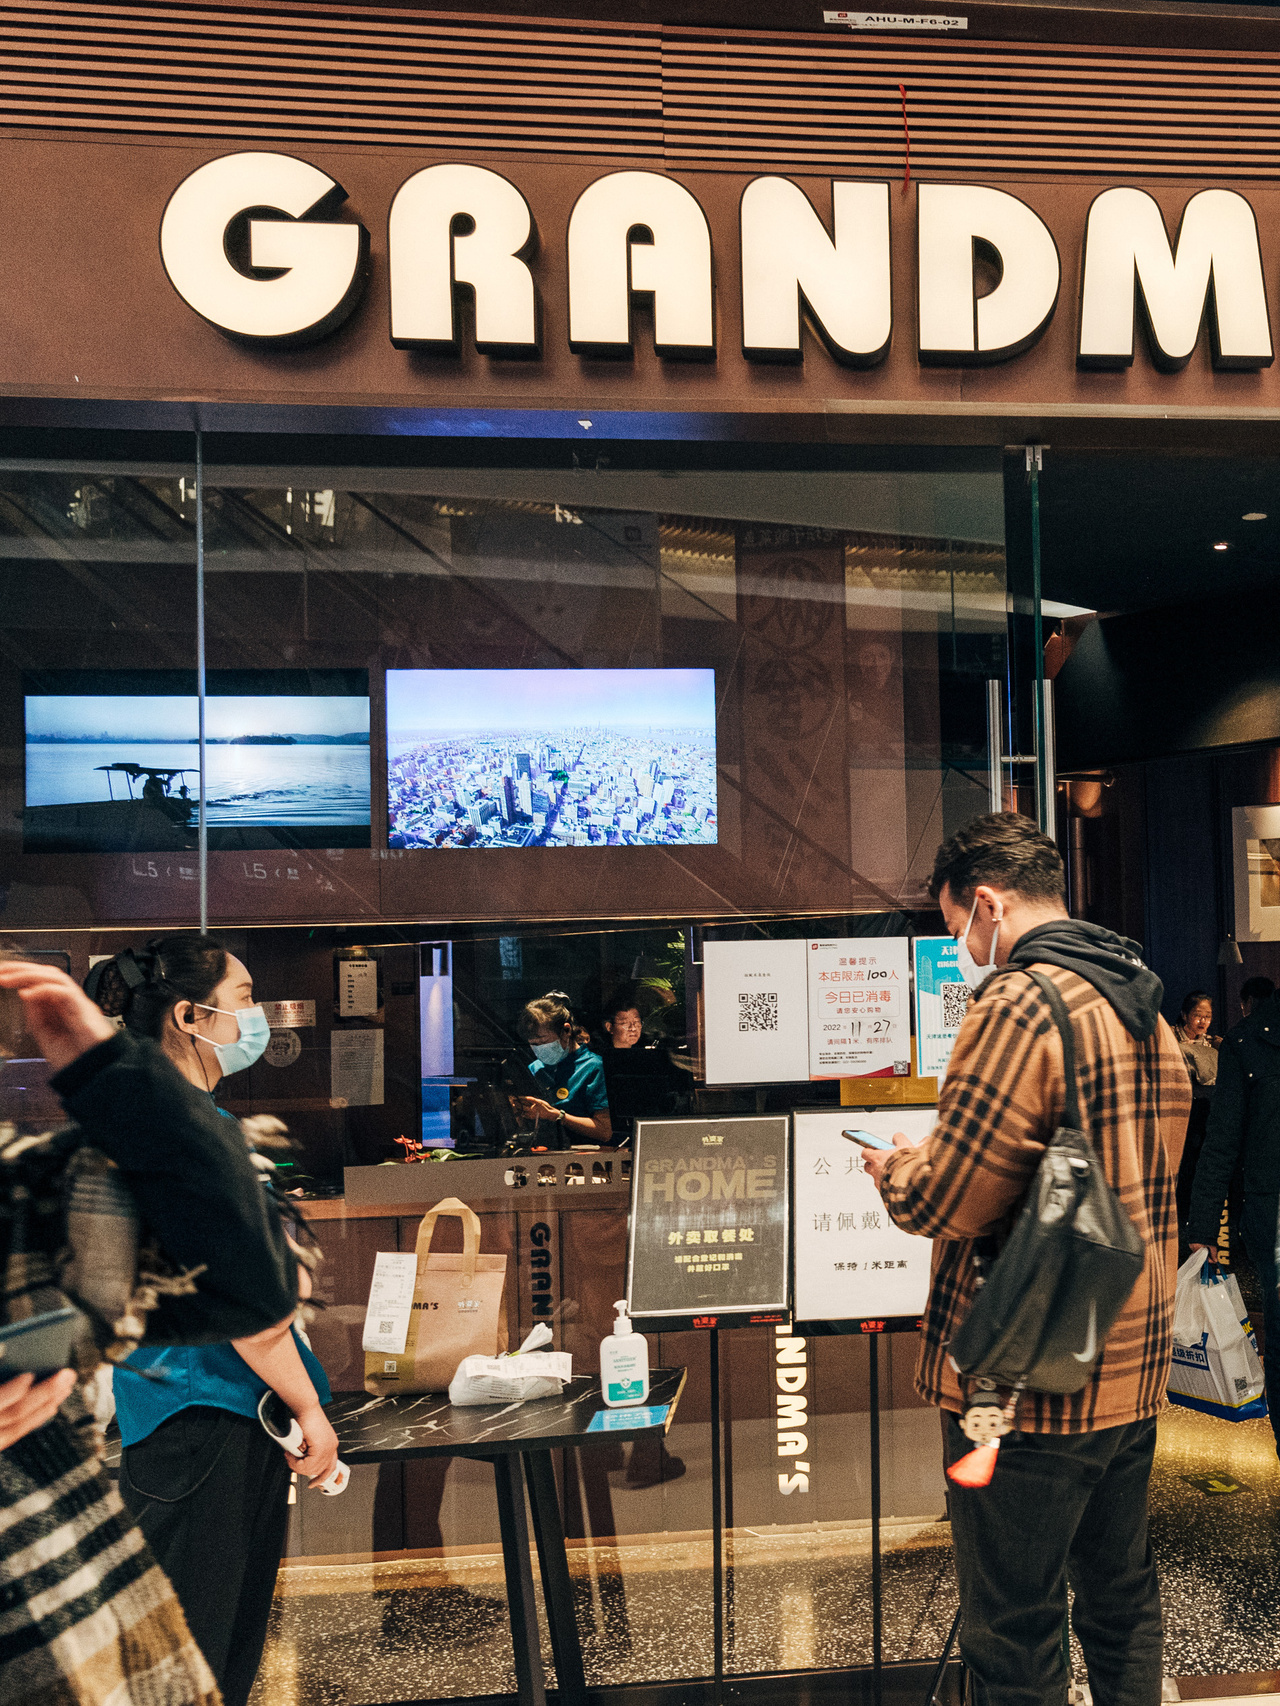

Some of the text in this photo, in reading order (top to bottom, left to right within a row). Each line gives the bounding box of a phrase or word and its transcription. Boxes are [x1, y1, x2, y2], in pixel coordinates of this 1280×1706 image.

[865, 16, 959, 26] AHU-M-F6-02
[839, 957, 877, 966] 温馨提示
[825, 990, 892, 1004] 今日已消毒
[643, 1168, 777, 1203] HOME
[668, 1228, 754, 1245] 外卖取餐处
[412, 1302, 439, 1310] MA'S
